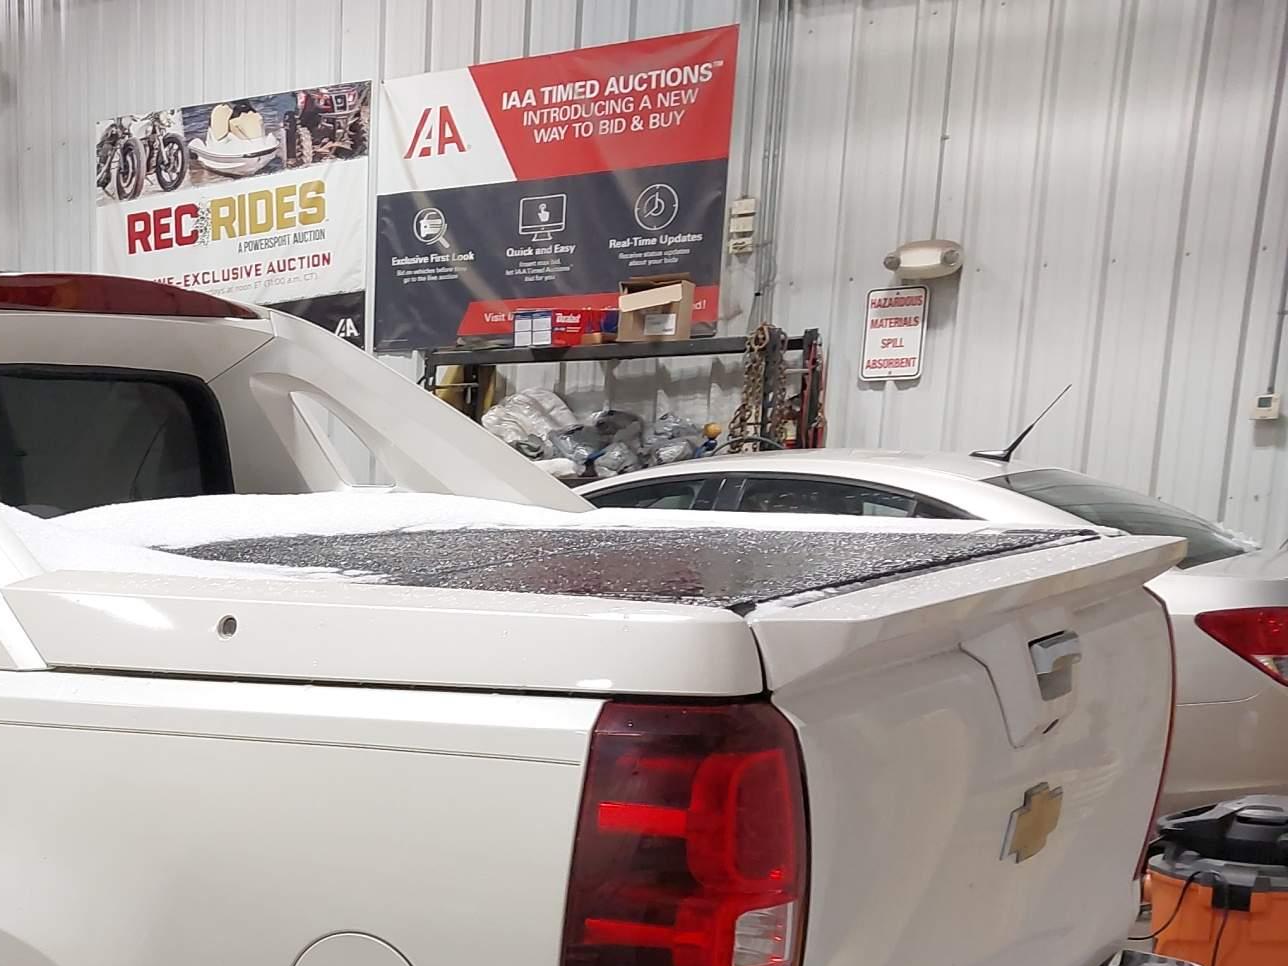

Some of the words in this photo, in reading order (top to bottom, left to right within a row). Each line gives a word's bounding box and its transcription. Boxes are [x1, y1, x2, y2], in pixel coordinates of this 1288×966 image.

[501, 91, 537, 111] IAA
[540, 79, 600, 106] TIMED
[523, 97, 635, 127] INTRODUCING
[639, 94, 652, 111] A
[656, 88, 699, 109] NEW
[533, 127, 570, 144] WAY
[572, 122, 594, 139] TO
[598, 119, 626, 136] BID
[629, 116, 645, 131] &
[648, 109, 686, 129] BUY
[127, 202, 200, 255] REC
[211, 179, 327, 241] RIDES
[244, 234, 291, 253] POWERSPORT
[293, 228, 326, 245] AUCTION
[609, 237, 657, 249] Real-Time
[659, 233, 703, 246] Updates
[392, 255, 429, 266] Exclusive
[430, 253, 450, 263] First
[452, 251, 475, 262] Look
[506, 246, 534, 258] Quick
[535, 245, 552, 255] and
[554, 244, 576, 255] Easy
[267, 252, 332, 275] AUCTION
[870, 295, 923, 309] HAZARDOUS
[484, 312, 505, 323] Visit
[870, 316, 919, 329] MATERIALS
[880, 337, 905, 349] SPILL
[865, 356, 917, 370] ABSORBENT
